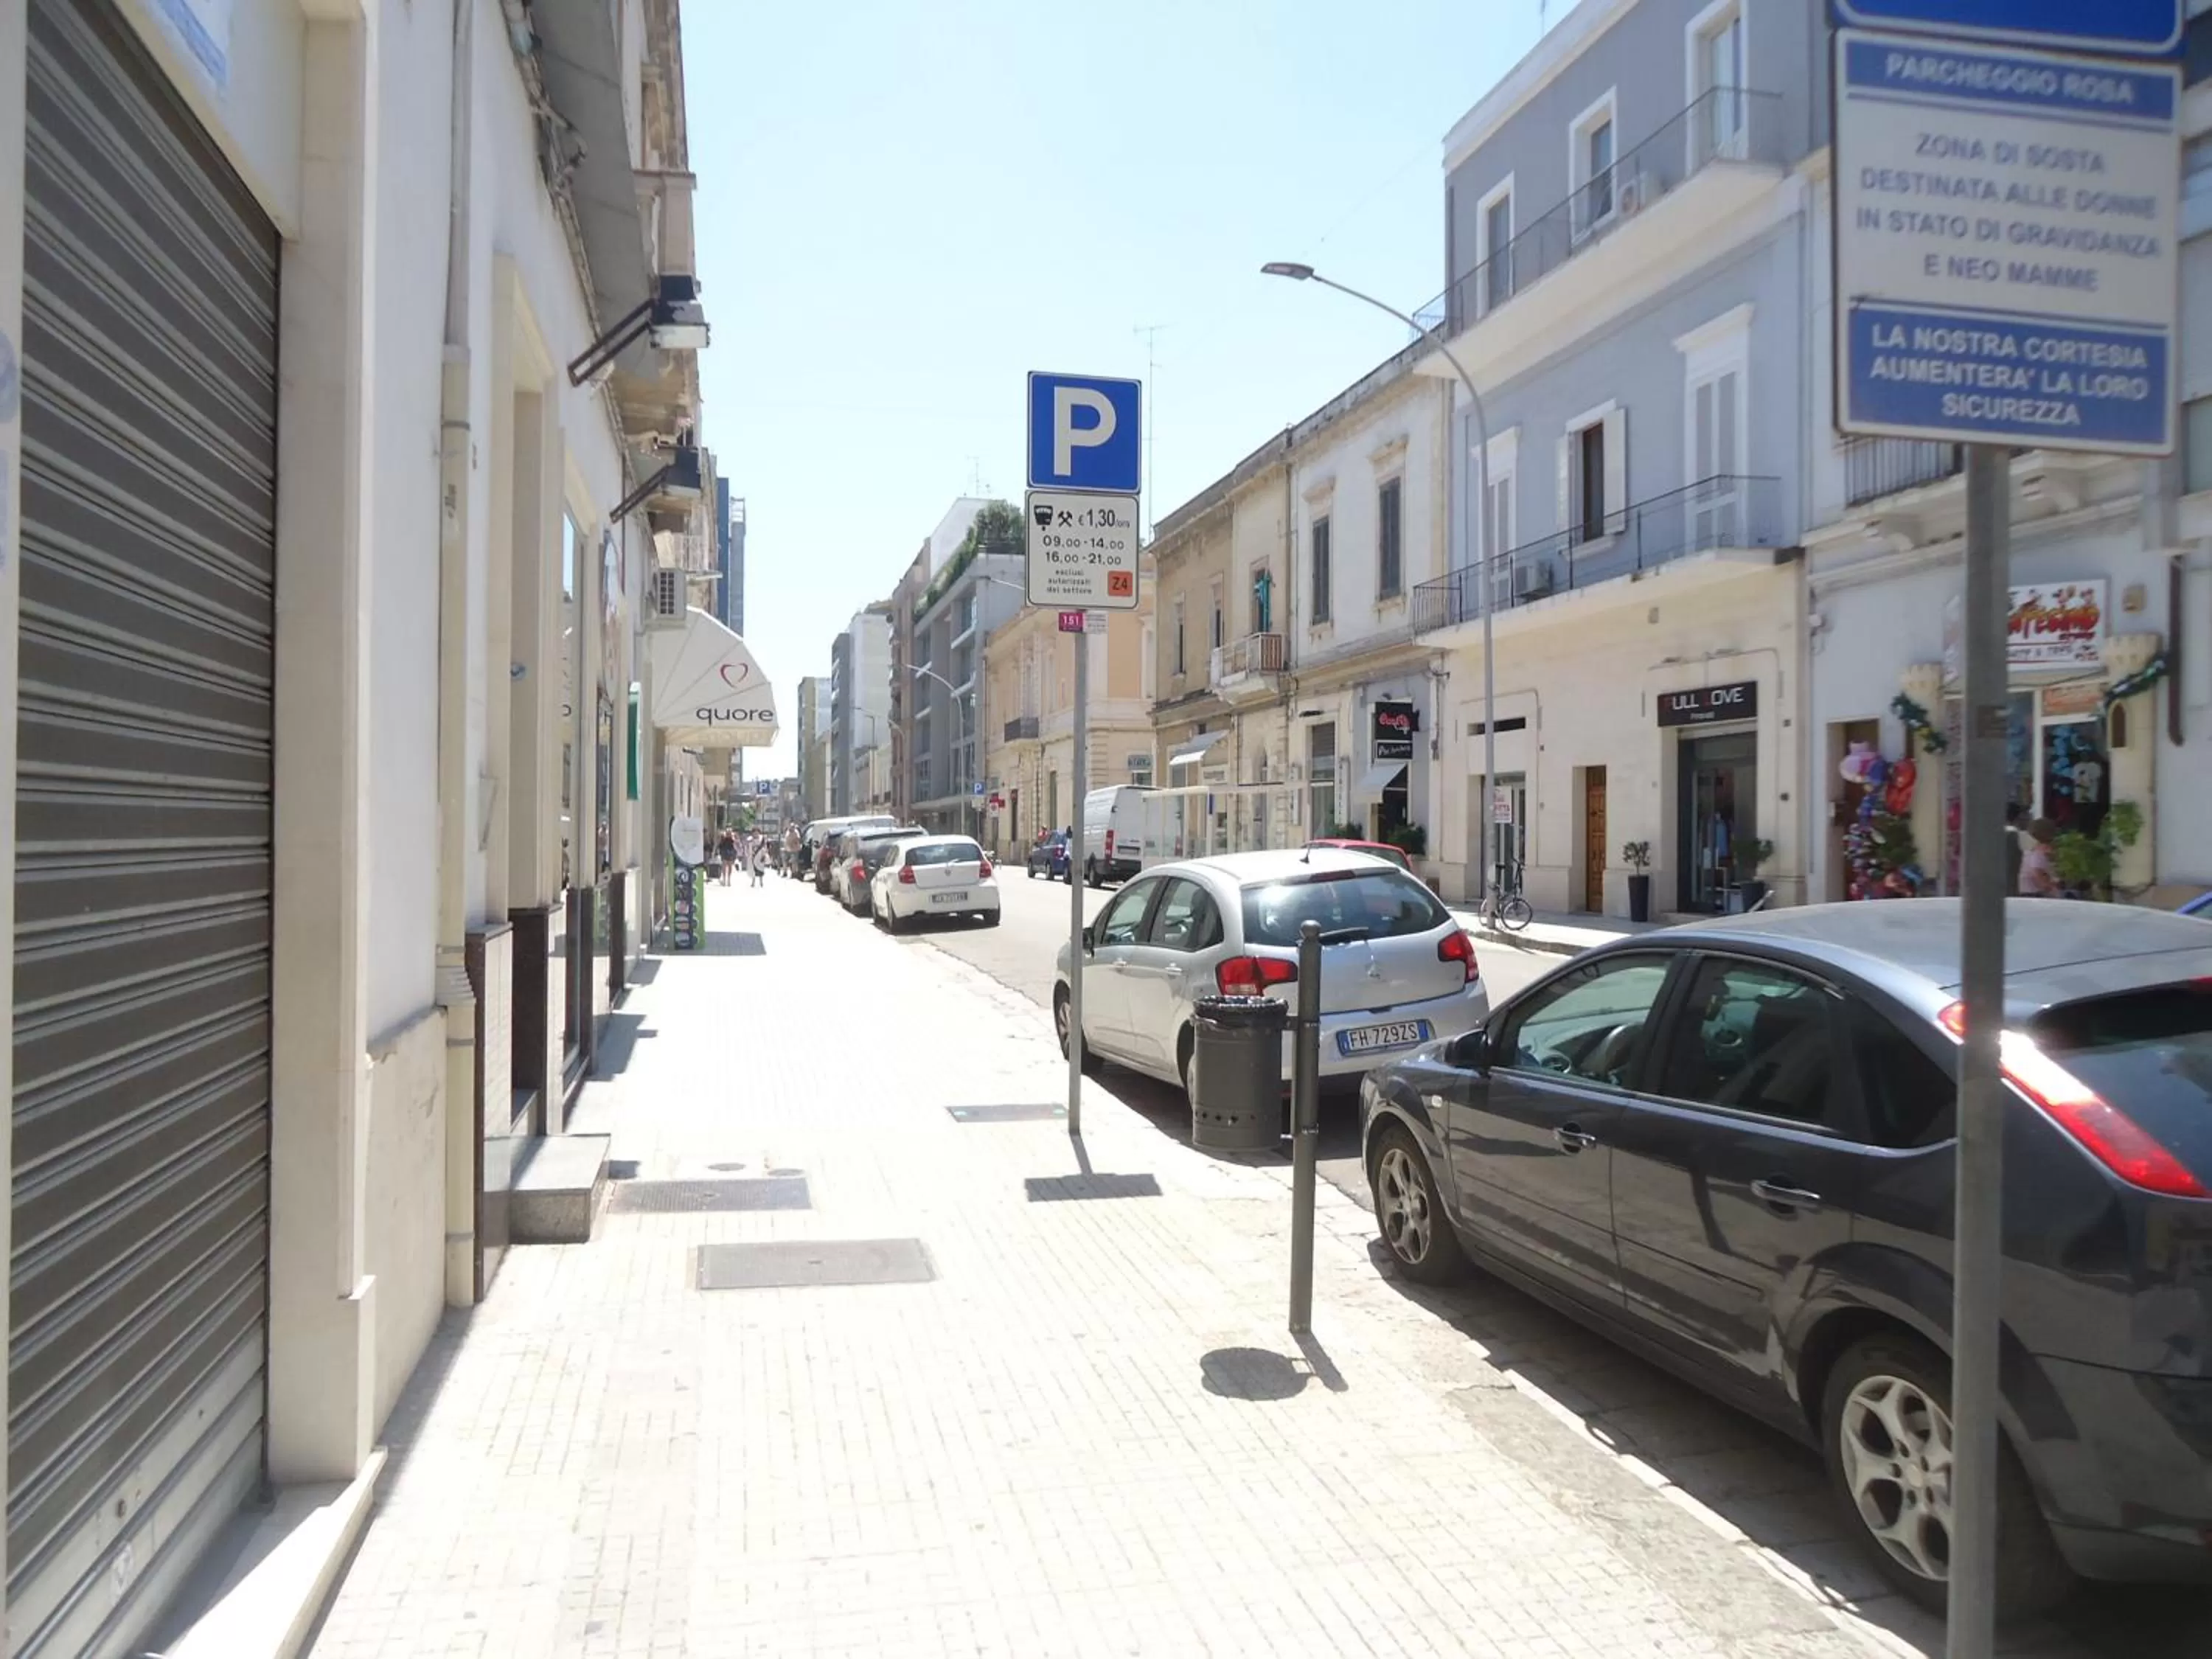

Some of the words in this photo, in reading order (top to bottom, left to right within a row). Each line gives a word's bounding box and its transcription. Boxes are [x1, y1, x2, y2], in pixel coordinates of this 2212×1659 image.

[1885, 53, 2056, 95] PARCHEGGIO
[2062, 74, 2134, 103] ROSA
[1916, 133, 1986, 160] ZONA
[1994, 141, 2018, 165] DI
[2026, 145, 2104, 173] SOSTA
[1860, 167, 1998, 203] DESTINATA
[2004, 183, 2067, 209] ALLE
[2074, 189, 2156, 219] DONNE
[1857, 207, 1879, 229] IN
[1888, 210, 1968, 239] STATO
[1976, 220, 2000, 240] DI
[2008, 223, 2160, 257] GRAVIDANZA
[1924, 254, 1939, 275] E
[1948, 256, 2000, 281] NEO
[2008, 262, 2098, 291] MAMME
[1872, 324, 1906, 349] LA
[1914, 327, 2017, 358] NOSTRA
[2024, 338, 2147, 368] CORTESIA
[2041, 372, 2073, 394] LA
[2079, 375, 2148, 400] LORO
[1941, 393, 2081, 425] SICUREZZA
[1054, 386, 1116, 476] P
[1112, 577, 1128, 591] Z4
[1062, 614, 1079, 626] 151
[696, 708, 773, 728] quore
